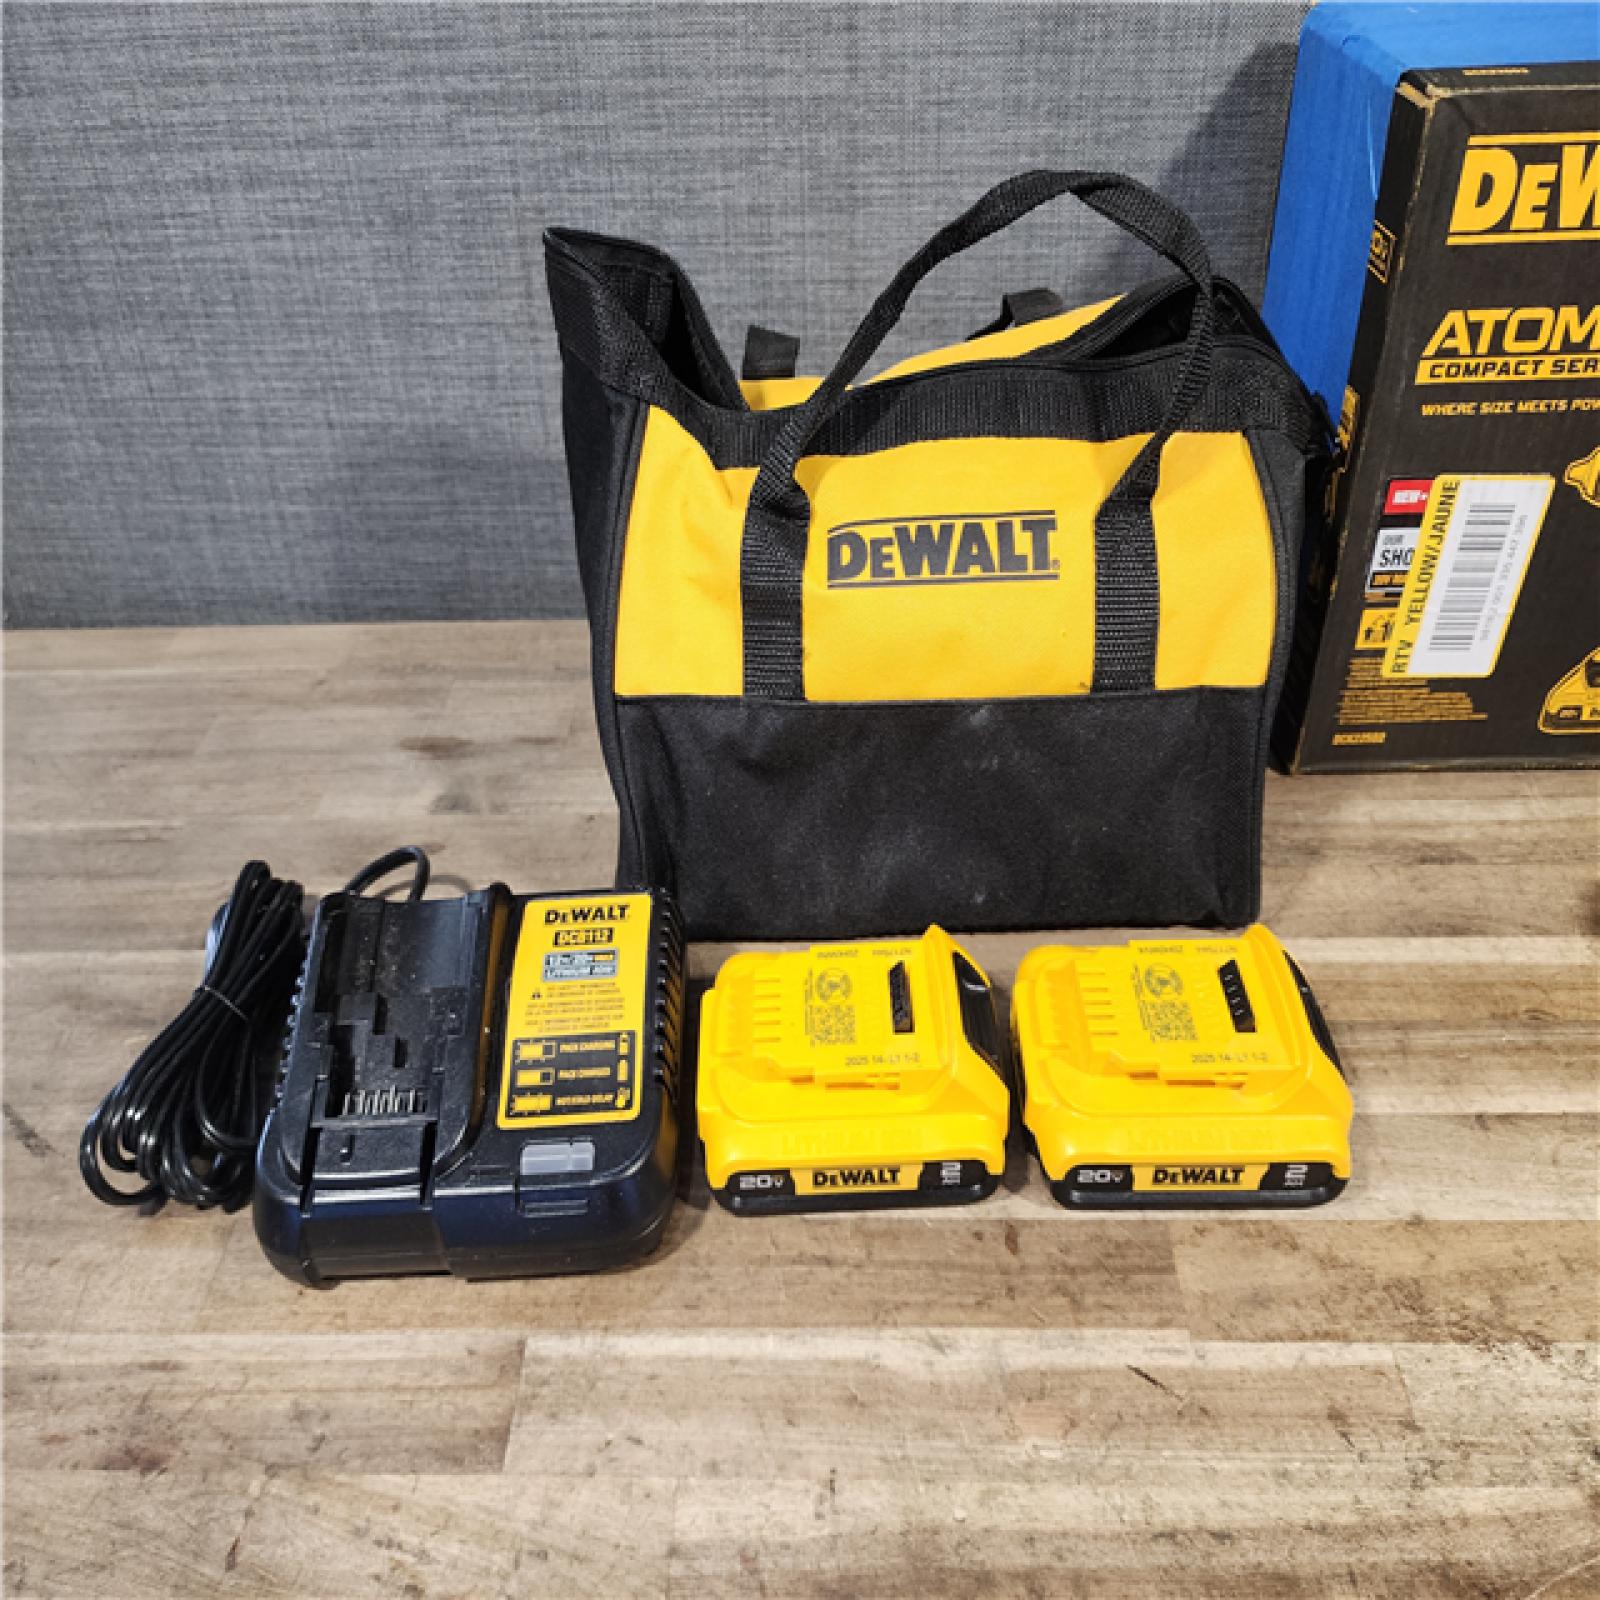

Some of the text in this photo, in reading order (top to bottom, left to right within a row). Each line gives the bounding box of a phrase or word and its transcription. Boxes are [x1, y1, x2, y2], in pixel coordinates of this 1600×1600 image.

[1429, 359, 1544, 379] COMPACT
[827, 518, 1058, 581] DEWALT
[1391, 640, 1412, 674] RTV
[545, 905, 628, 925] DEWALT
[812, 1167, 901, 1187] DEWALT
[1152, 1165, 1246, 1185] DEWALT
